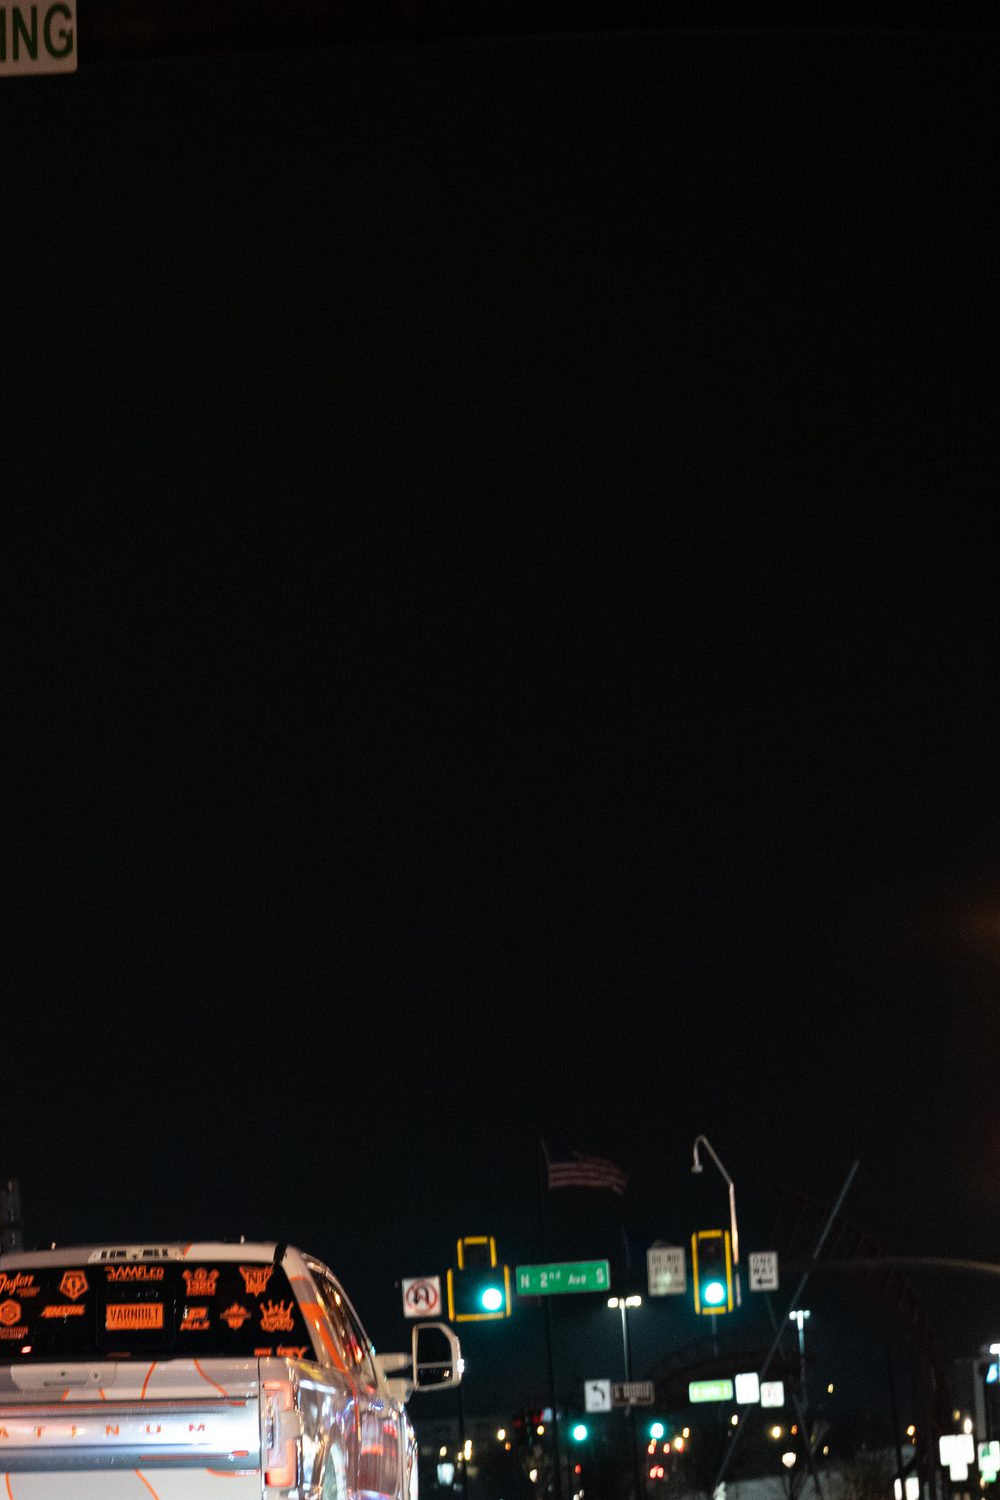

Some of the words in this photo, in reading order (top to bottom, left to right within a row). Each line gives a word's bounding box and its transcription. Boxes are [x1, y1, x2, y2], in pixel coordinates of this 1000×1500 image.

[520, 1273, 530, 1288] N
[540, 1270, 562, 1288] 2nd
[568, 1273, 587, 1285] Ave
[596, 1267, 605, 1284] S
